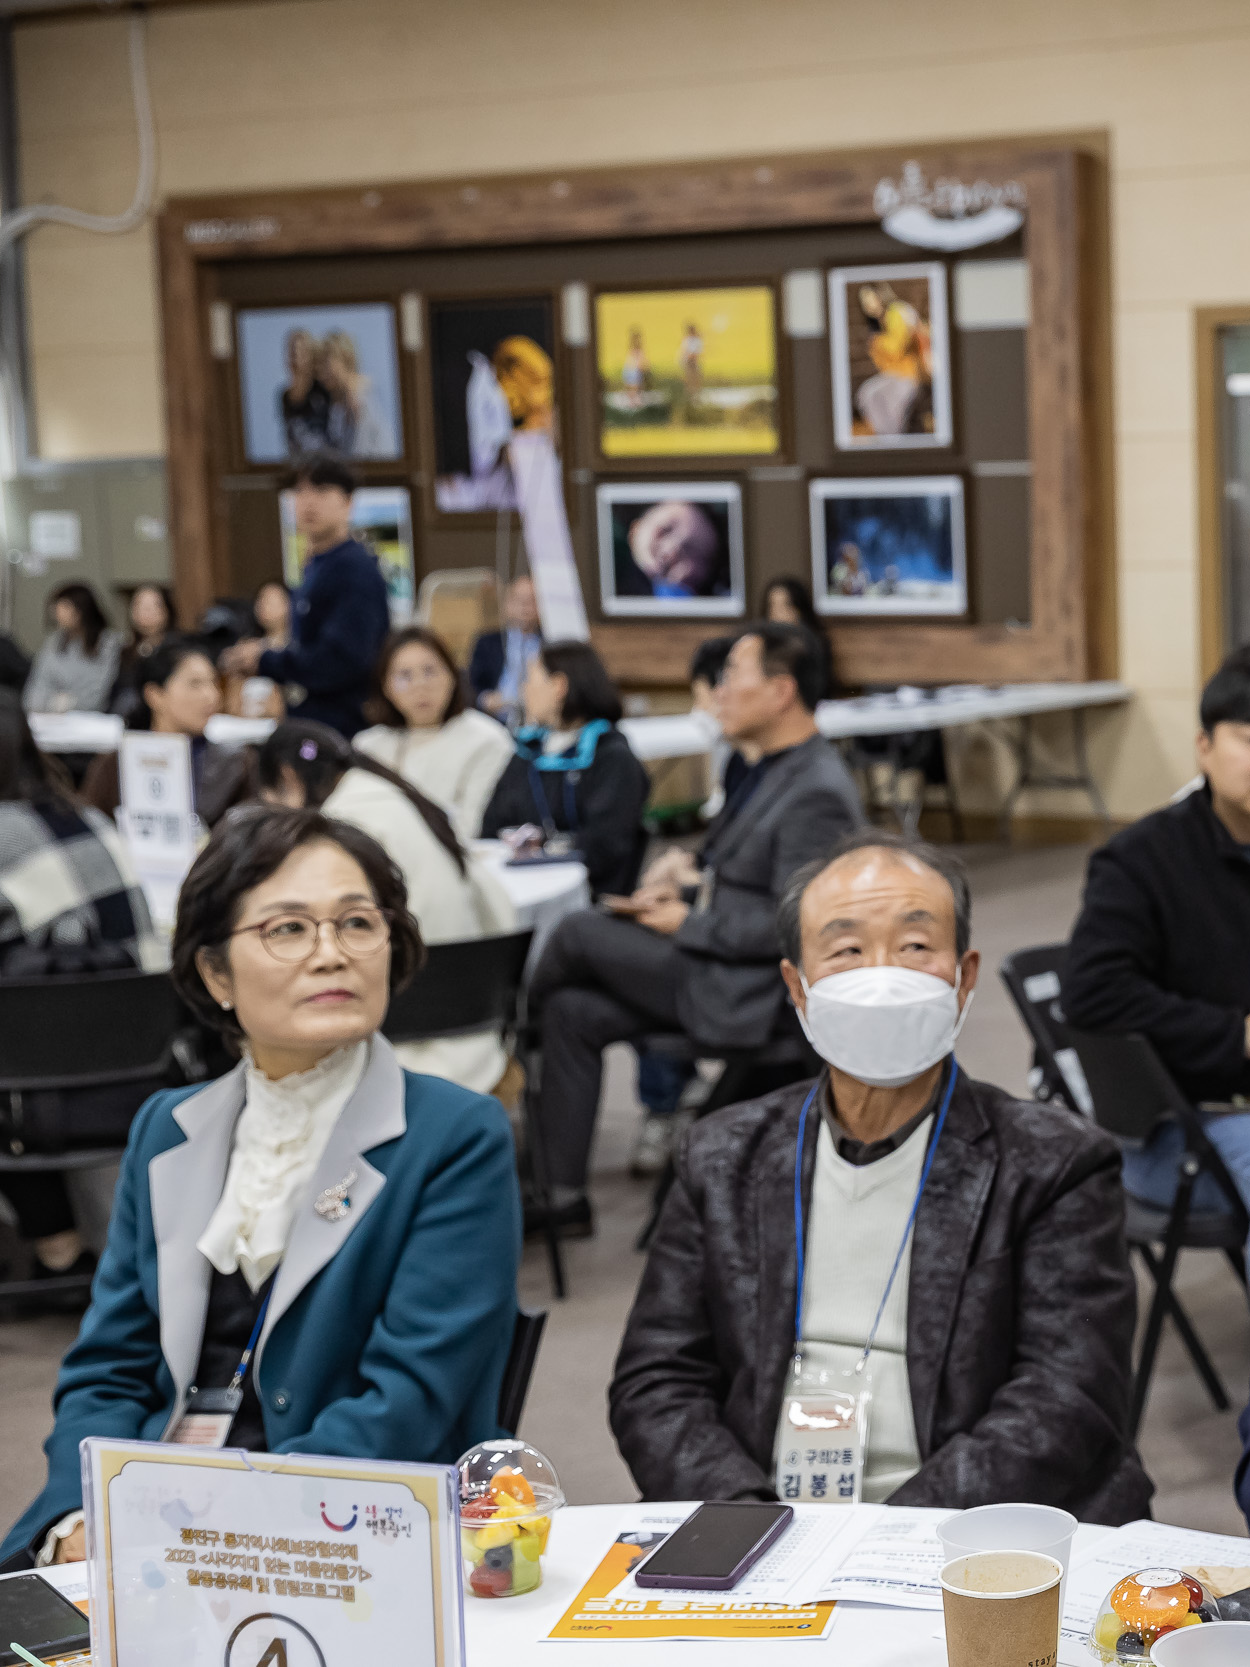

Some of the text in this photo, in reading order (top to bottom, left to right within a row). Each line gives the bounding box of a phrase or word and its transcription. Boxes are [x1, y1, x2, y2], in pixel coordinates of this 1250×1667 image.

[805, 1448, 853, 1465] 구의2동
[164, 1548, 196, 1564] 2023
[263, 1557, 291, 1576] 없는
